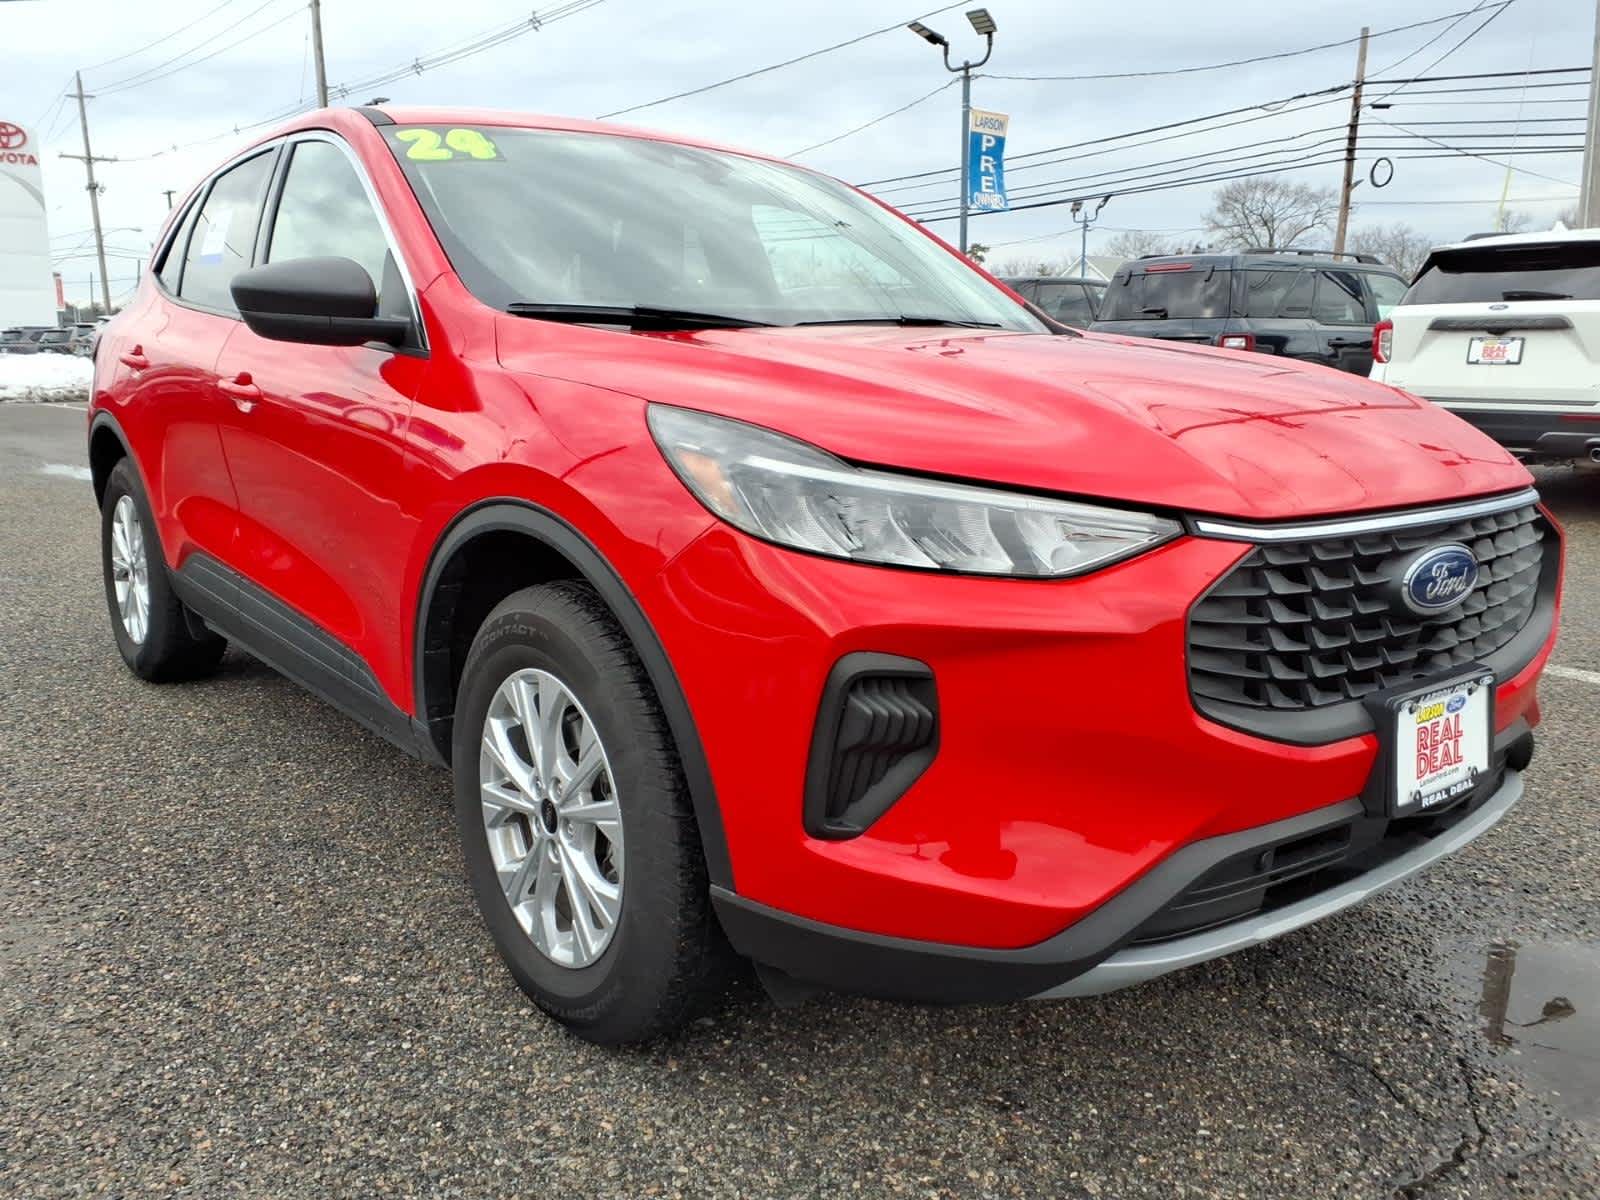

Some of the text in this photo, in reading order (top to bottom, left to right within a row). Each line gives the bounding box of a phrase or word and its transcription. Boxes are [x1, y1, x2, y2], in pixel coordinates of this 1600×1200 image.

[974, 115, 1005, 131] LARSON
[981, 134, 996, 193] PRE
[1426, 560, 1469, 600] Ford
[1417, 713, 1463, 753] REAL
[1416, 739, 1463, 780] DEAL
[1422, 778, 1474, 808] REAL DEAL
